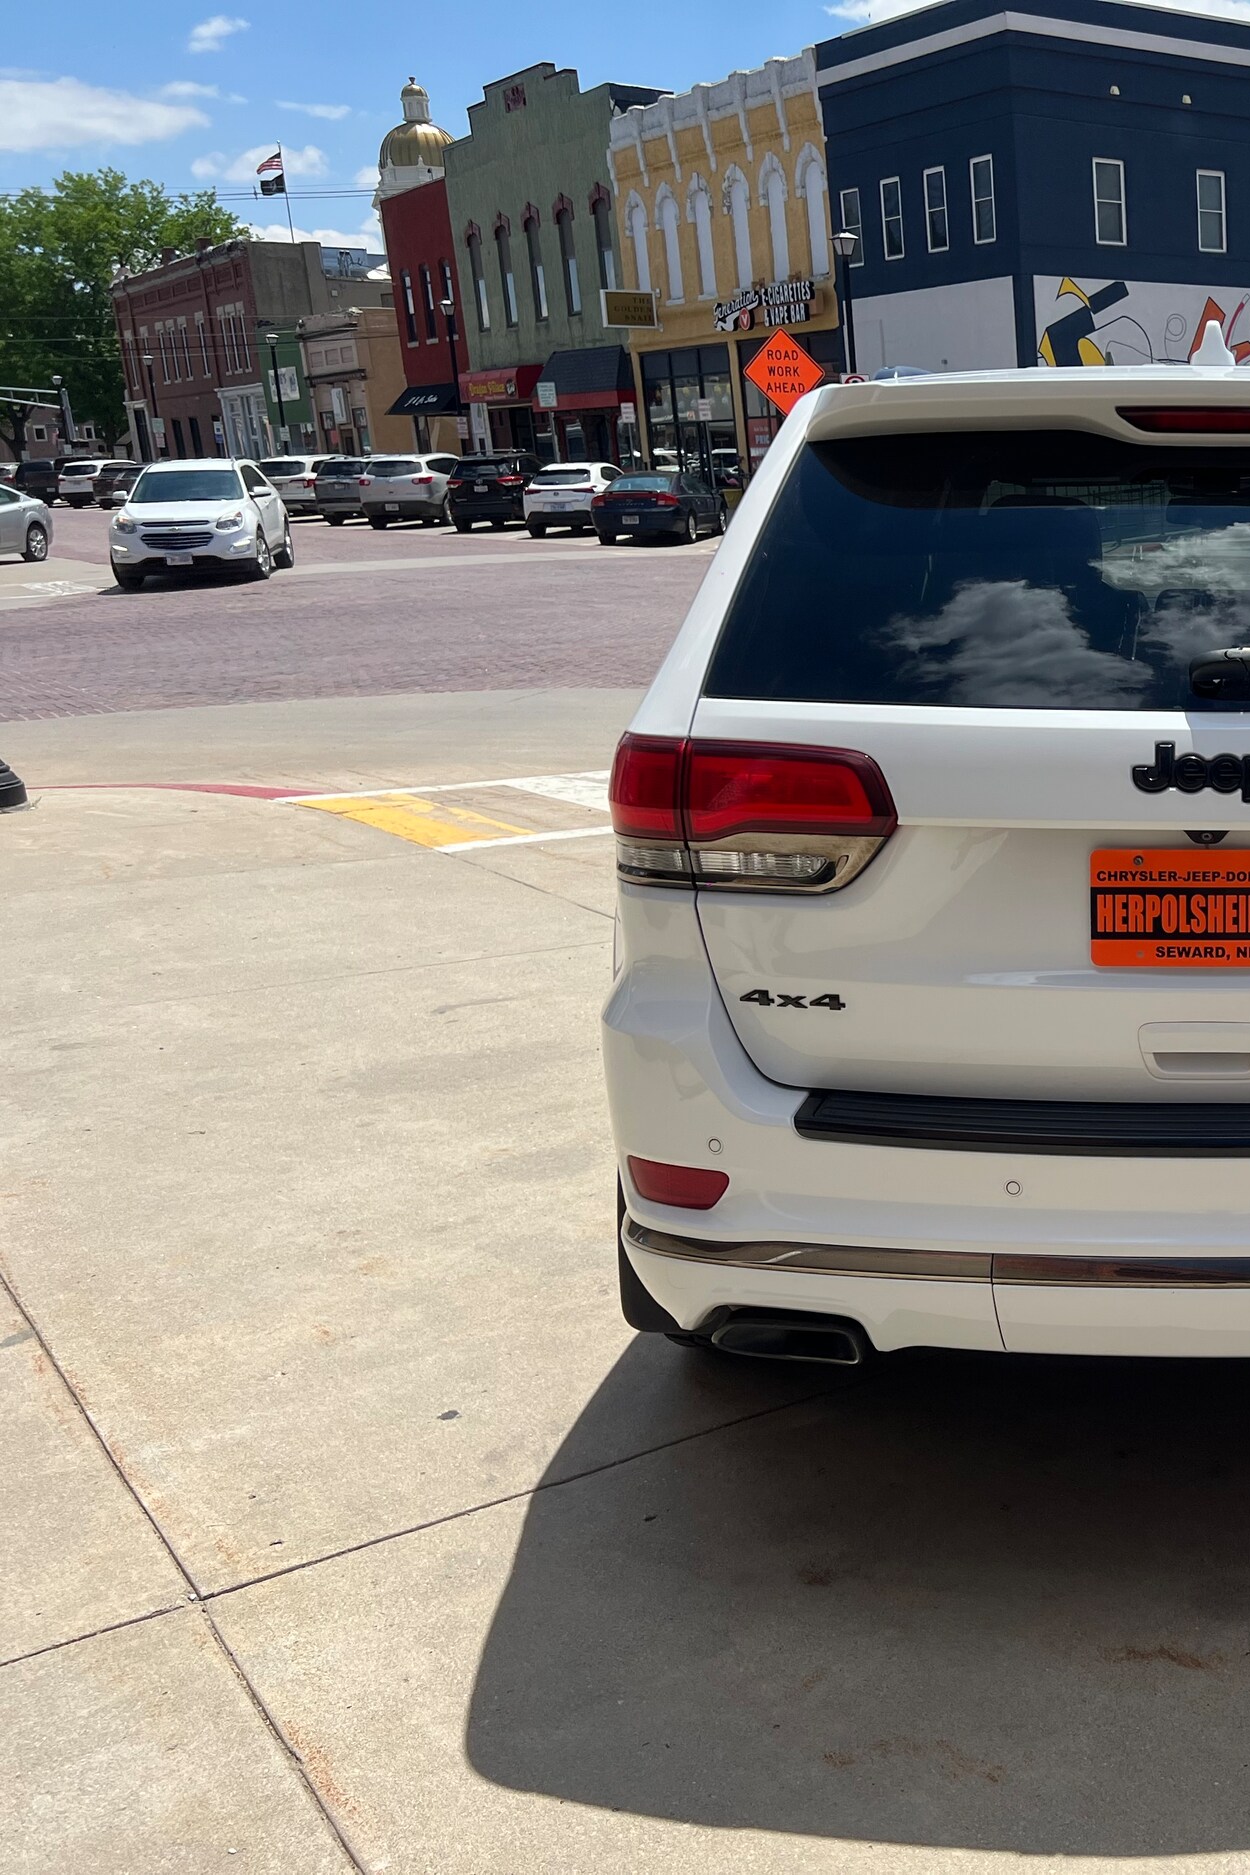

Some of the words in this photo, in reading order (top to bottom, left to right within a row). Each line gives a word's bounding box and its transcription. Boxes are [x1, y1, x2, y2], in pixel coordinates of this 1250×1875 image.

[761, 280, 811, 307] E-CIGARETTES
[770, 305, 788, 326] VAPE
[790, 303, 806, 323] BAR
[767, 350, 799, 361] ROAD
[767, 366, 800, 377] WORK
[766, 382, 805, 393] AHEAD
[1155, 946, 1231, 961] SEWARD,
[740, 989, 846, 1011] 4x4
